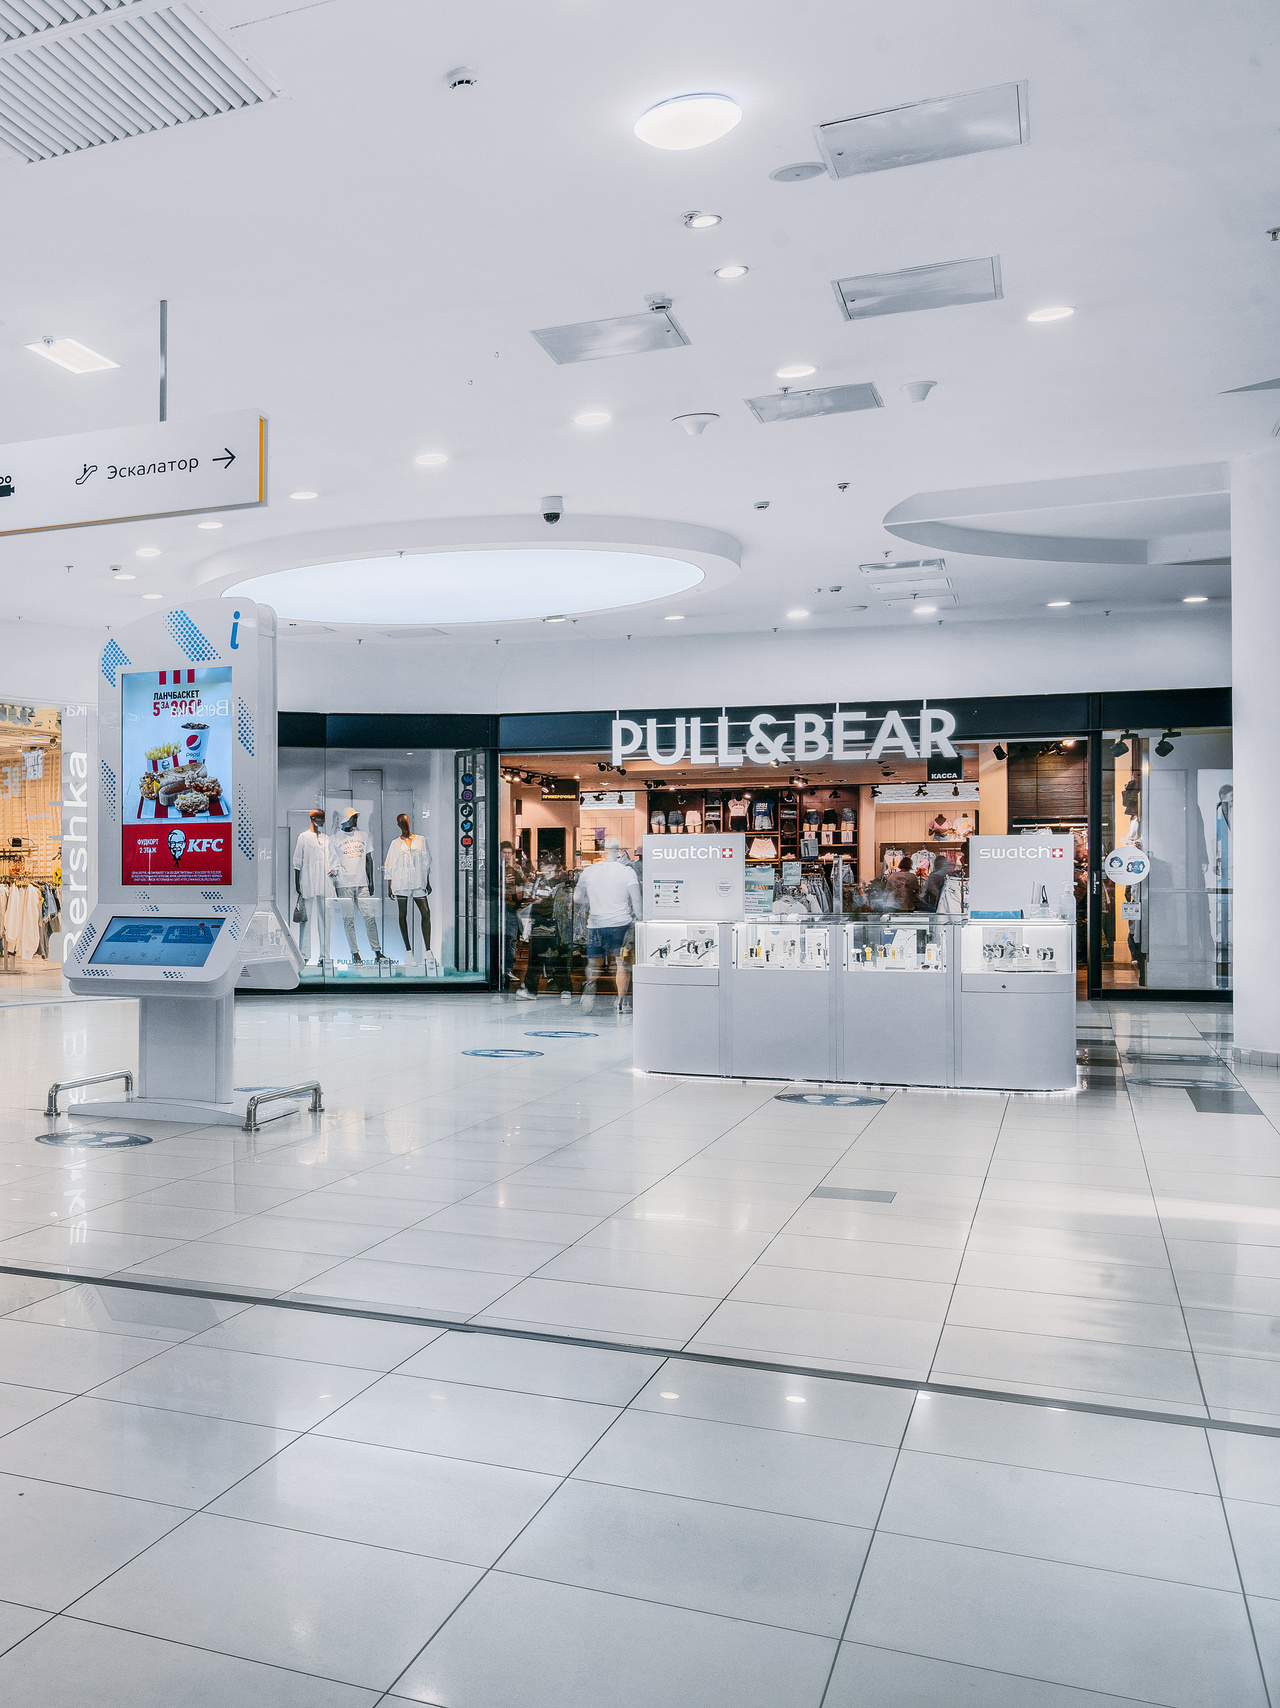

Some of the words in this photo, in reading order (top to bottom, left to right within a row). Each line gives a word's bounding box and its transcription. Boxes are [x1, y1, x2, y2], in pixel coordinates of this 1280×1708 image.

[106, 455, 199, 480] Эскалатор
[153, 690, 200, 700] ЛАНЧБАСКЕТ
[153, 702, 160, 716] 5
[611, 709, 959, 766] PULL&BEAR
[931, 772, 958, 780] КАССА
[187, 838, 224, 853] KFC
[652, 845, 720, 860] swatch
[979, 845, 1051, 859] swatch
